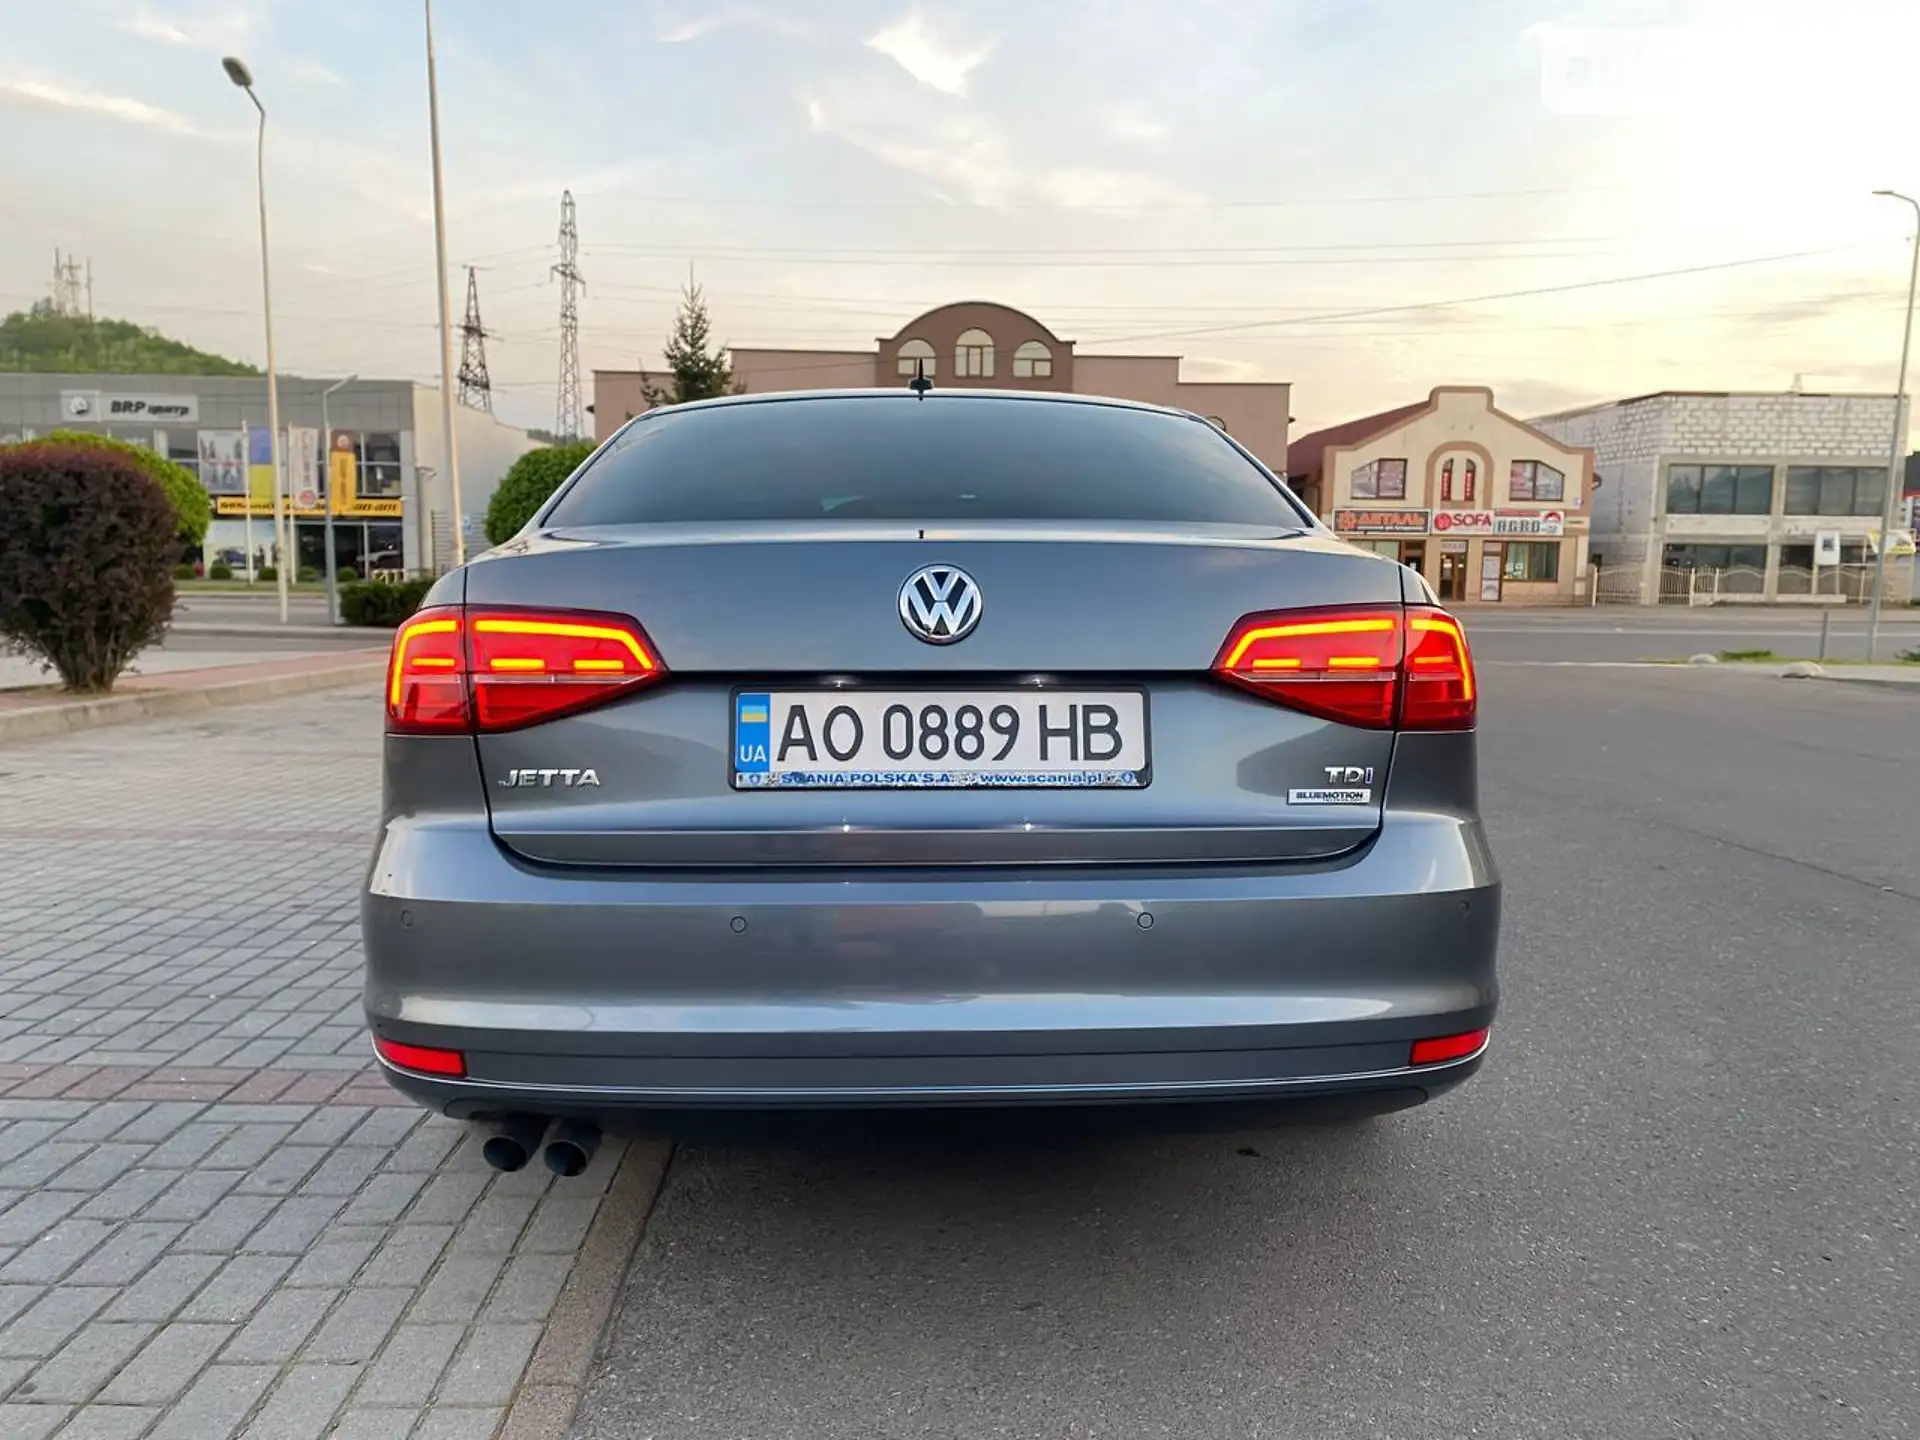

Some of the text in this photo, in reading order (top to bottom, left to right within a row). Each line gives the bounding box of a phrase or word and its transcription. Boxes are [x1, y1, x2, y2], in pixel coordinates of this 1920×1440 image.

[110, 399, 146, 414] BRP
[1452, 512, 1492, 527] SOFA
[776, 704, 1123, 762] AO 0889 HB
[740, 744, 767, 763] UA
[498, 768, 600, 787] JETTA
[850, 773, 918, 784] POLSKA
[1324, 766, 1374, 784] TDI
